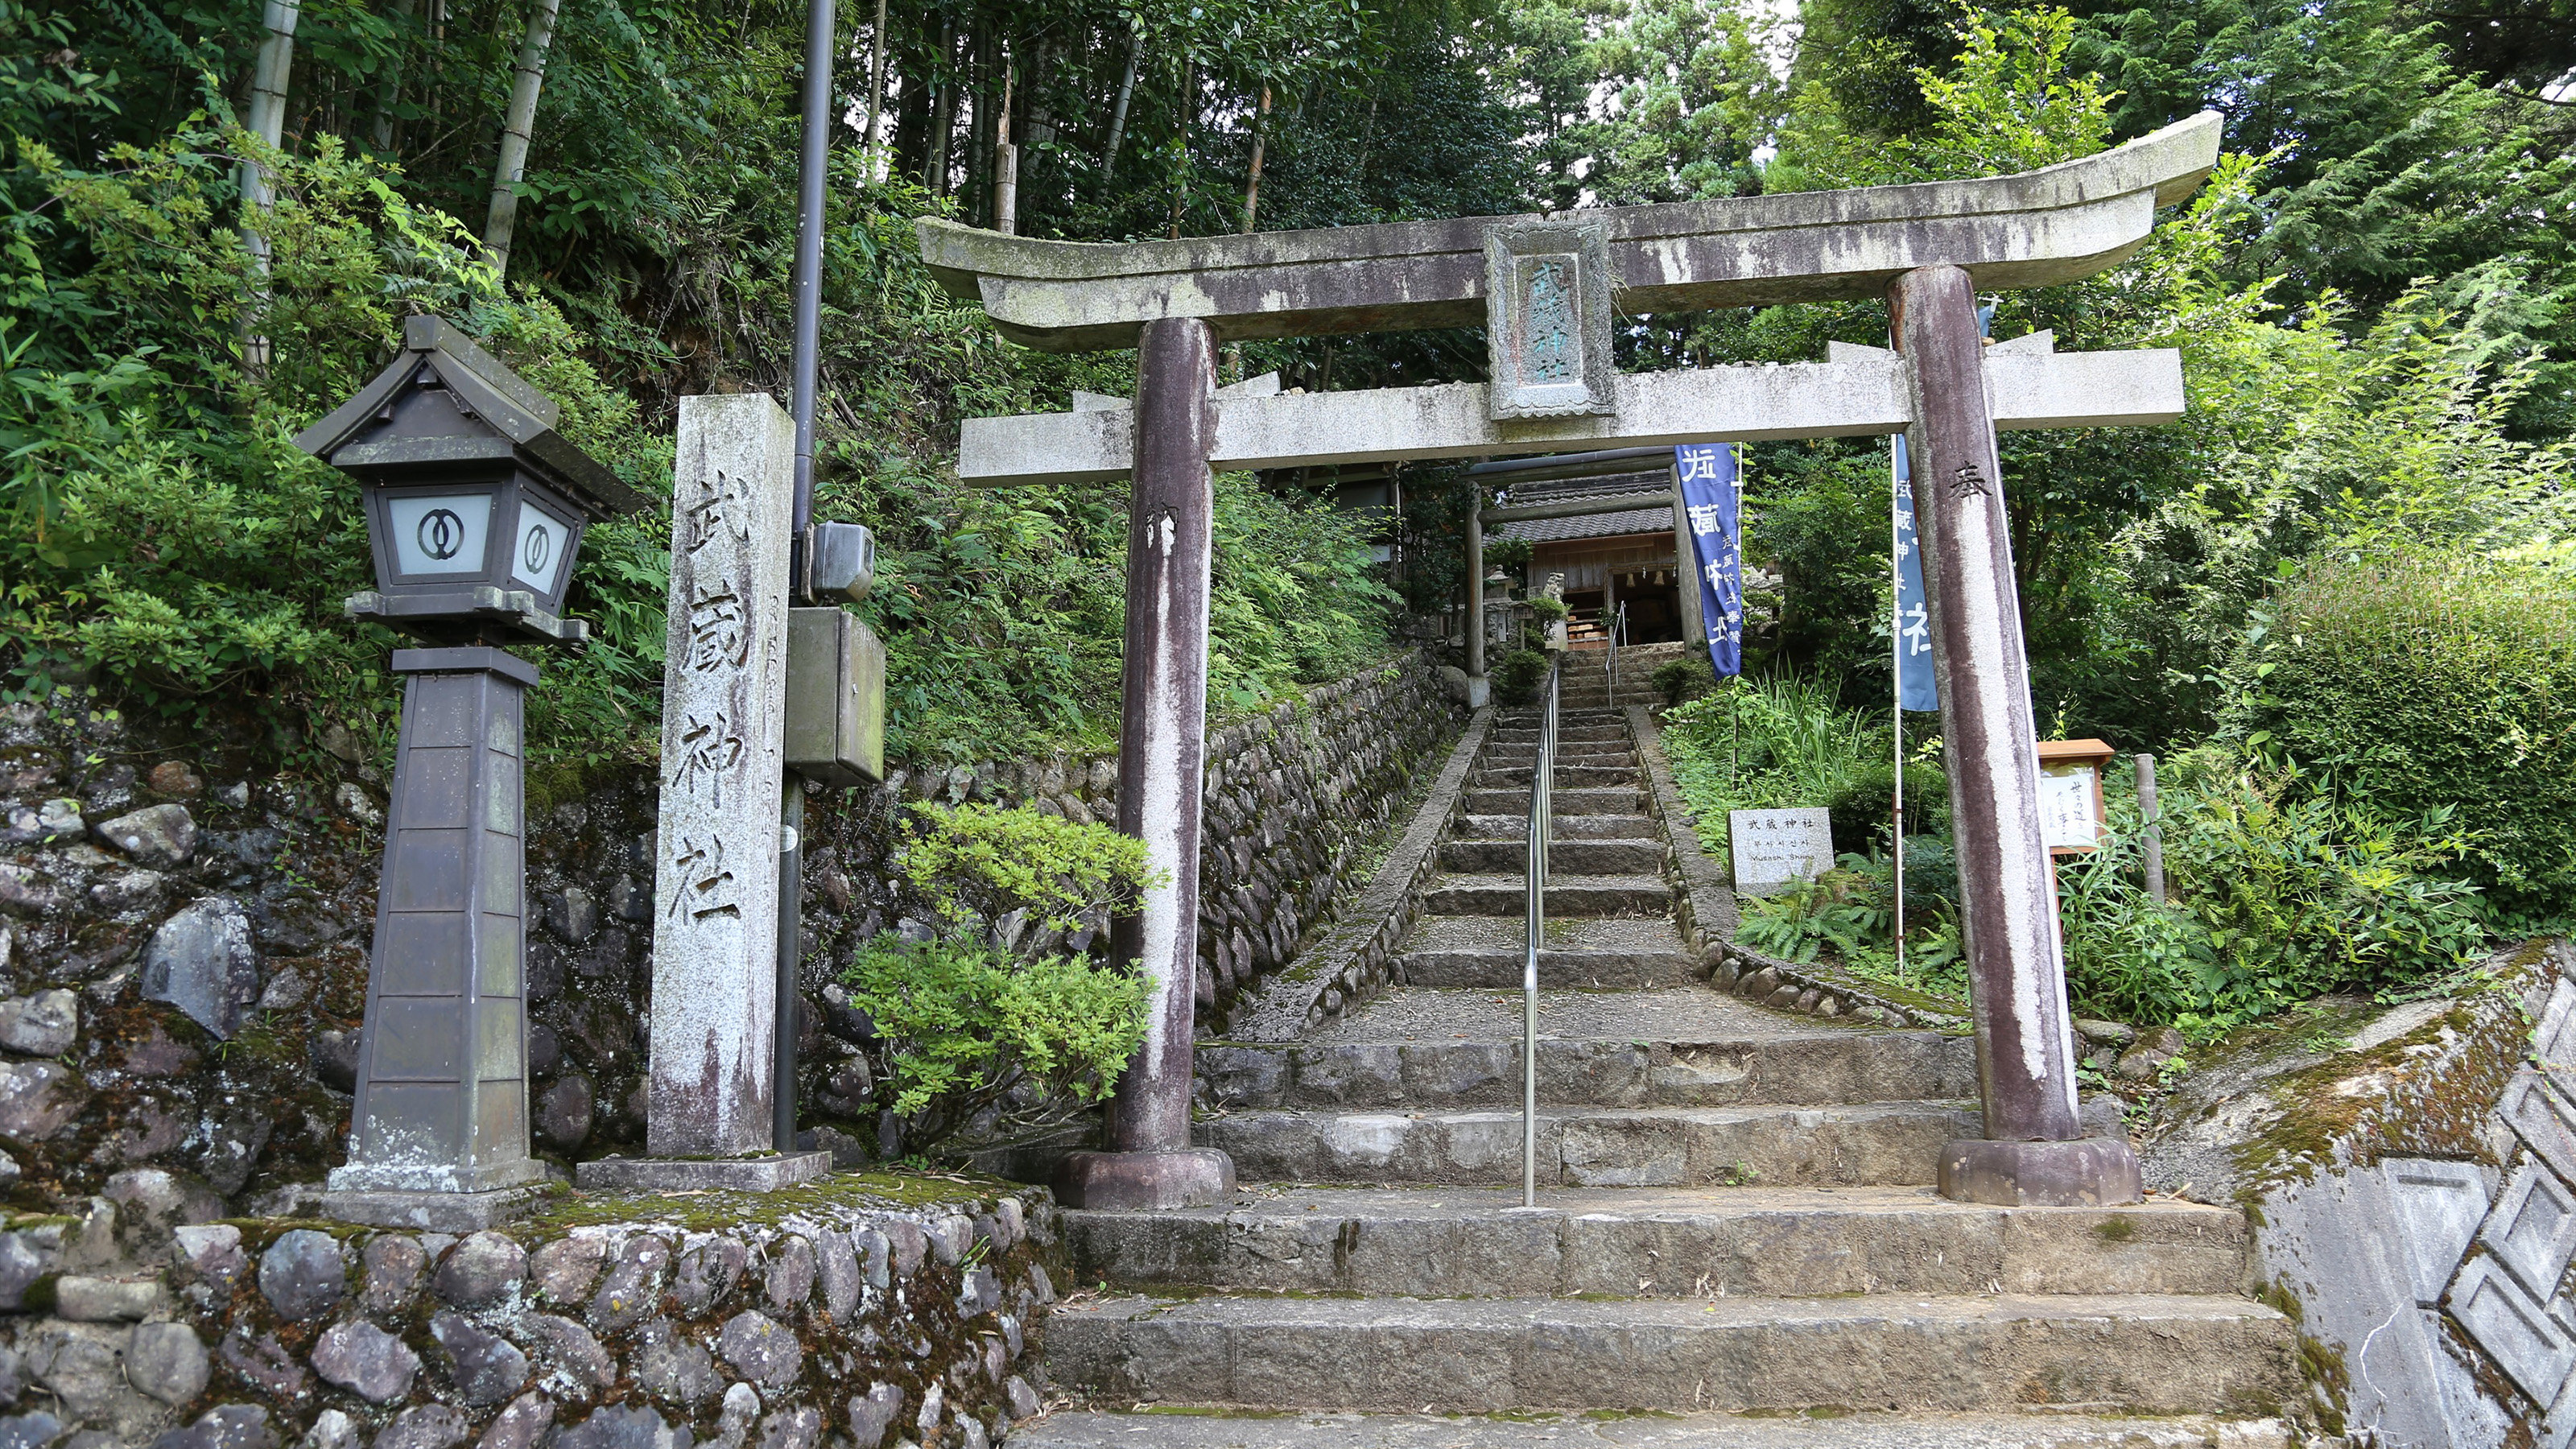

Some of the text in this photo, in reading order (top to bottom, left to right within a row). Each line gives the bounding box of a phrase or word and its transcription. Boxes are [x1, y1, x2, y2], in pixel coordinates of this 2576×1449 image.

[1948, 460, 1992, 506] 奉
[667, 469, 749, 927] 武蔵神社
[1748, 818, 1815, 831] 武蔵神社
